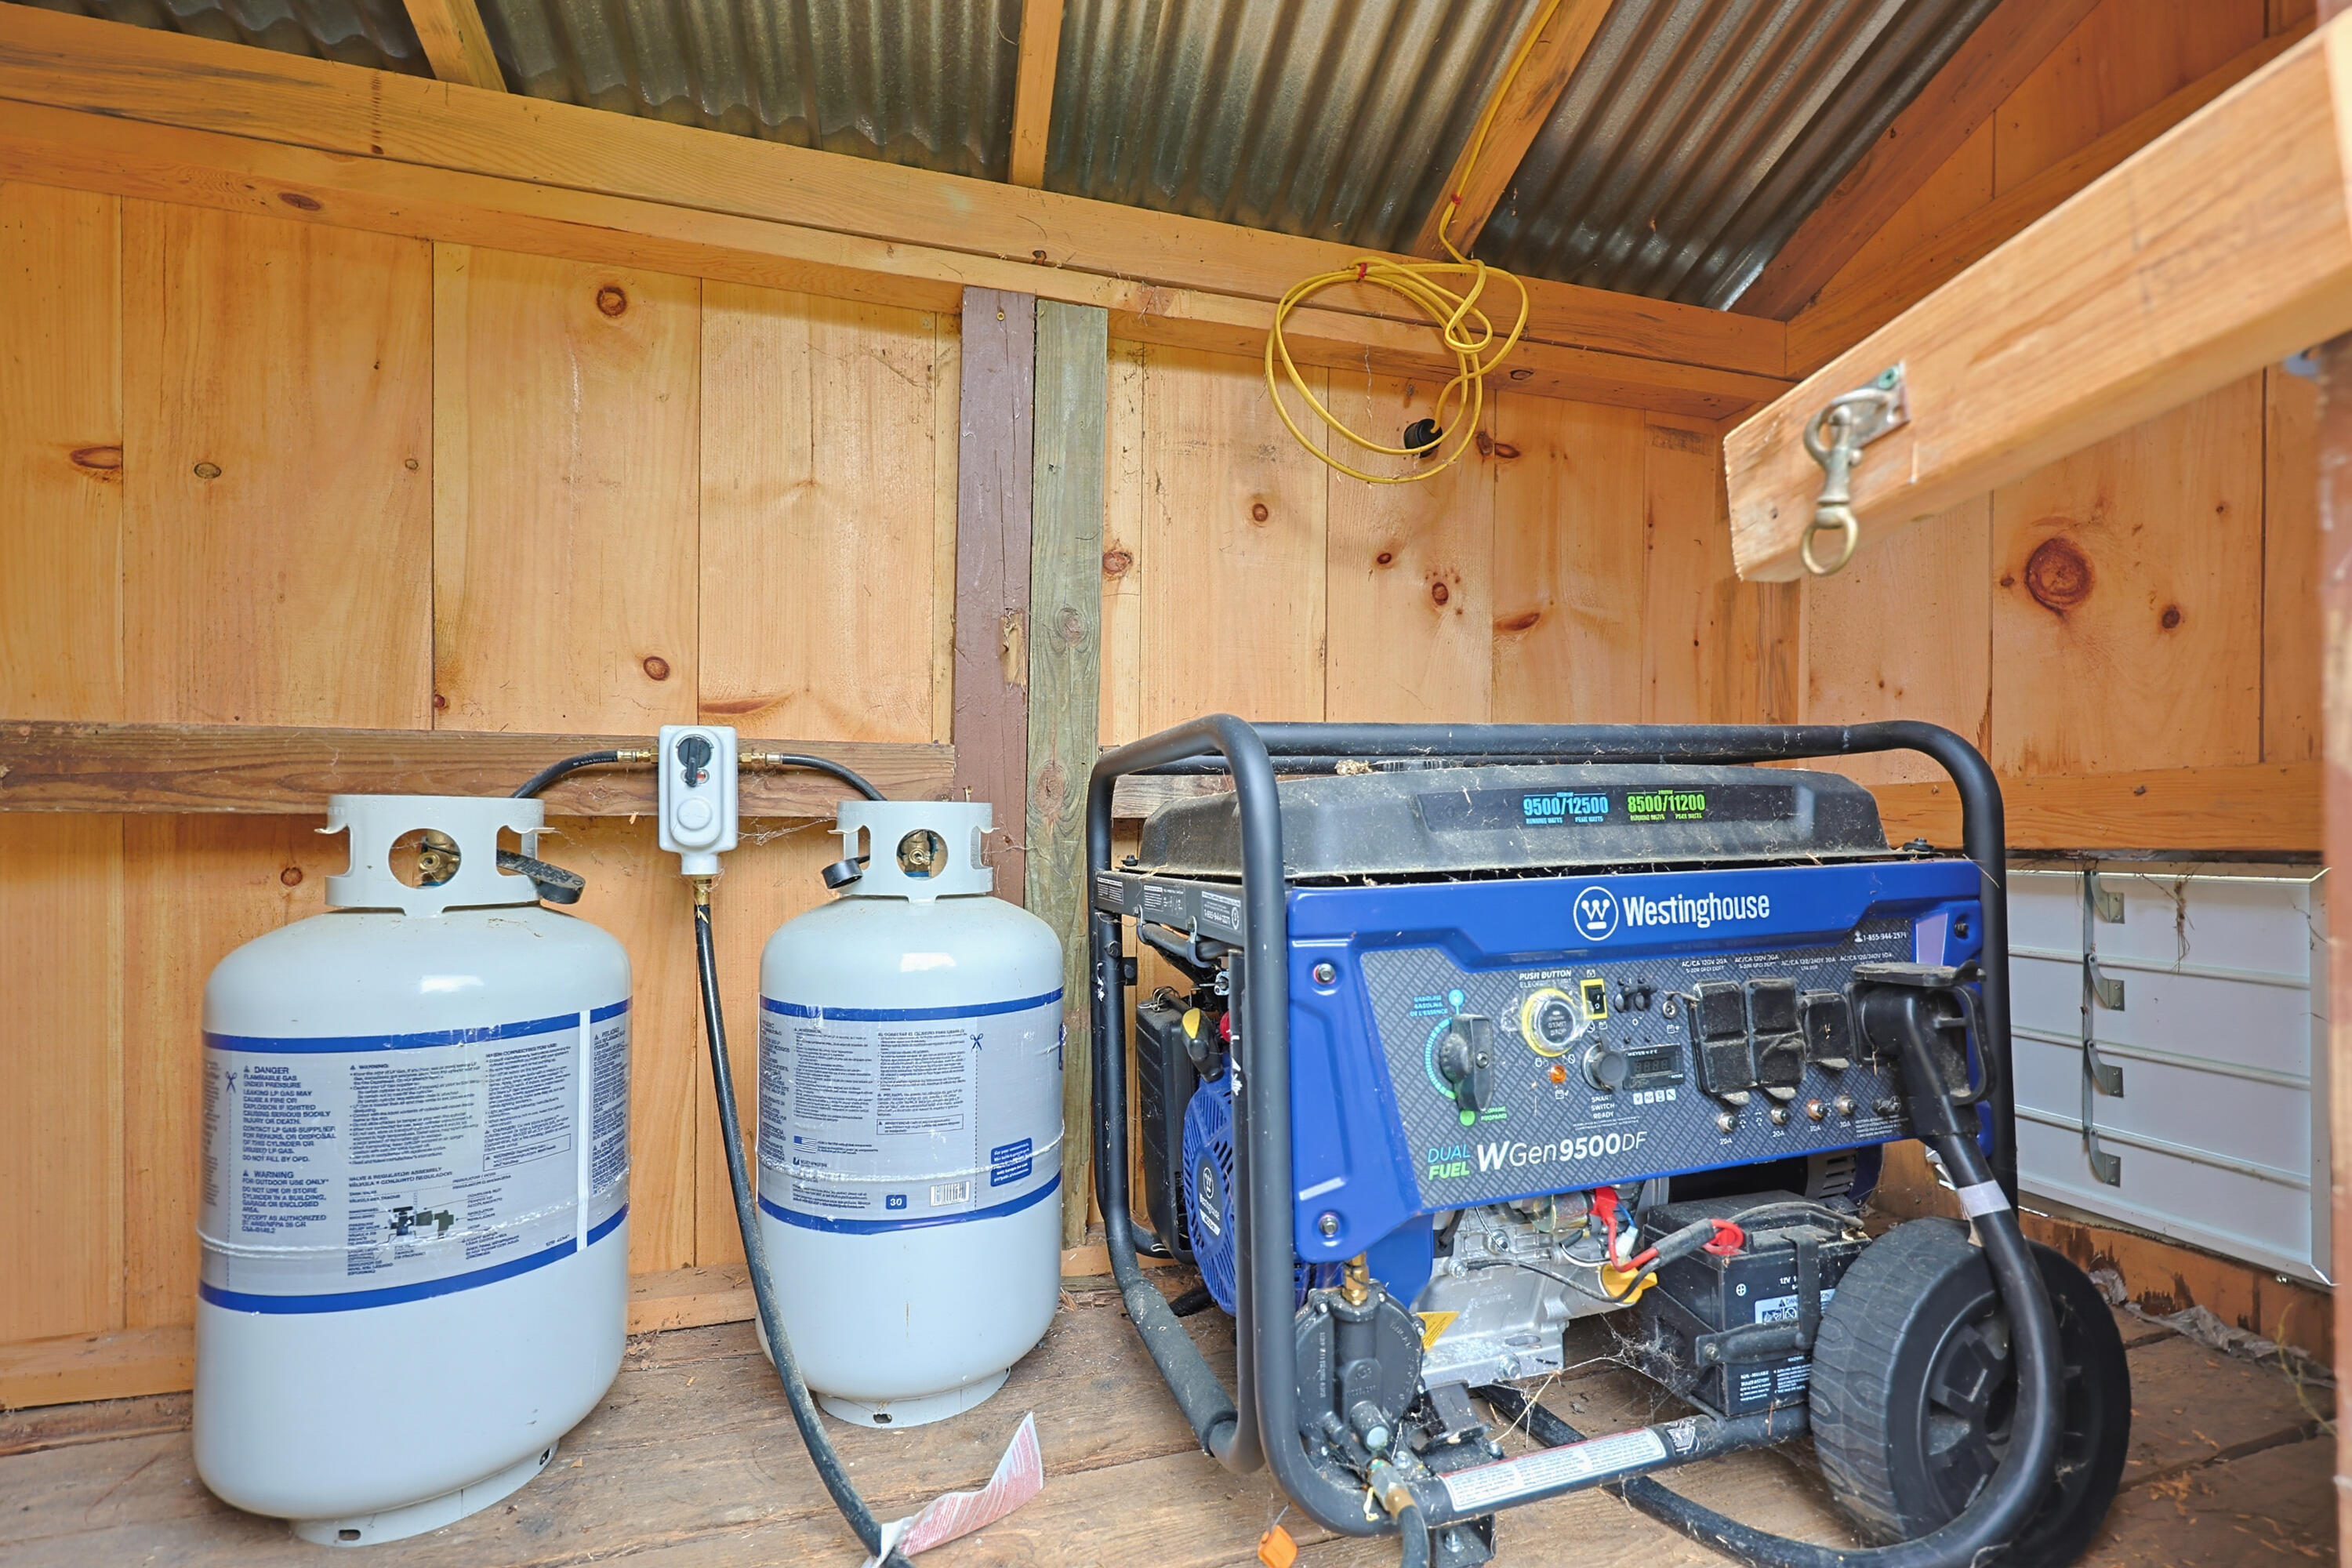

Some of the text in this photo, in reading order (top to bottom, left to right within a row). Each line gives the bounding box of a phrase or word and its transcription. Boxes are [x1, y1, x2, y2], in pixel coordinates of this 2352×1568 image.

[1523, 797, 1609, 816] 9500/12500
[1628, 794, 1705, 813] 8500/11200
[1622, 892, 1770, 928] Westinghouse
[1519, 969, 1572, 981] PUSH BUTTON
[1592, 1094, 1613, 1103] SMART
[1593, 1111, 1614, 1120] READY
[1428, 1143, 1471, 1163] DUAL
[253, 1171, 294, 1179] WARNING
[1428, 1161, 1470, 1181] FUEL
[890, 1198, 902, 1207] 30
[1779, 1276, 1791, 1285] 12V
